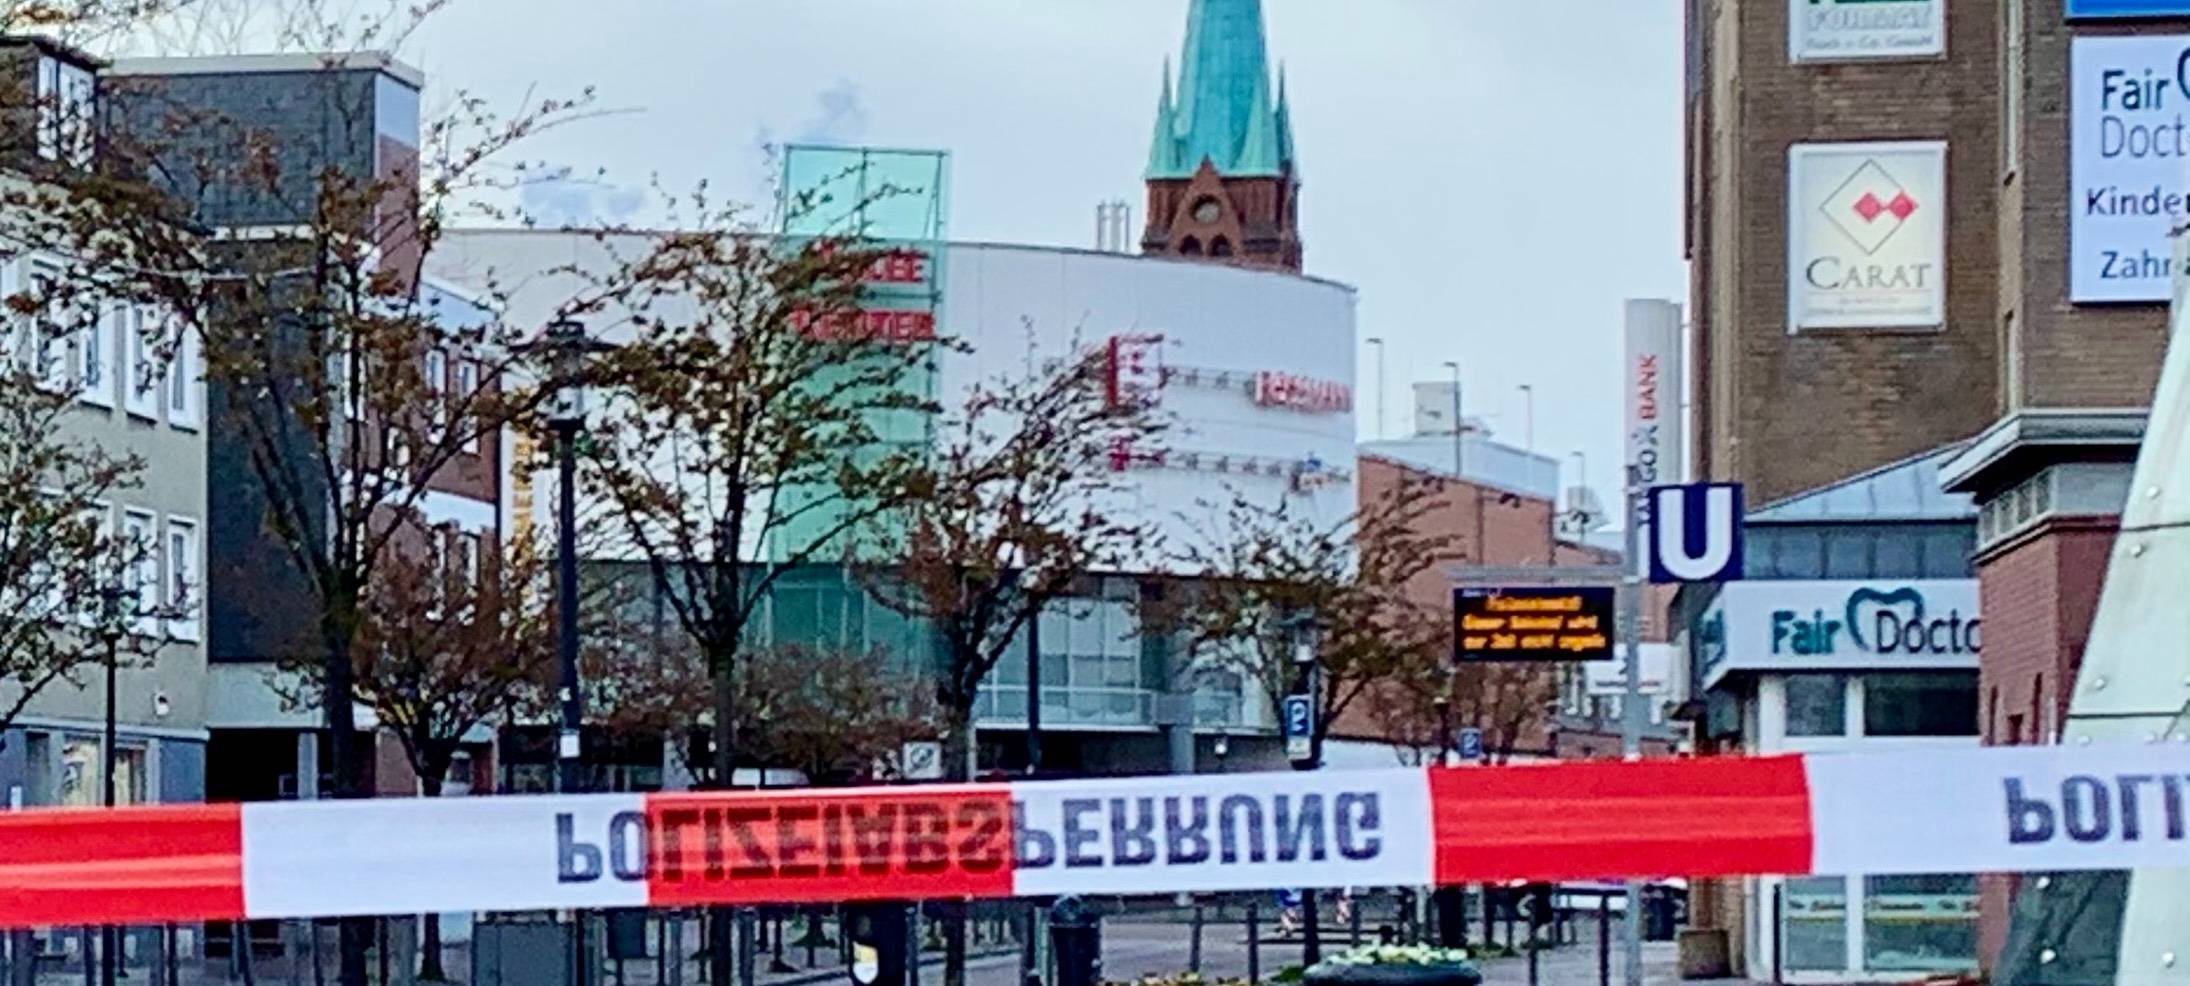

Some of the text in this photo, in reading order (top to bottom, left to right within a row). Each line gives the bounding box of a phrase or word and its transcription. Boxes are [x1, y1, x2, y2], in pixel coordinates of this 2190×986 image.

[2101, 69, 2170, 111] Fair
[1805, 256, 1932, 290] CARAT
[1637, 354, 1659, 421] BANK
[1658, 486, 1733, 580] U
[1772, 609, 1841, 655] Fair
[1876, 608, 1981, 654] Docto
